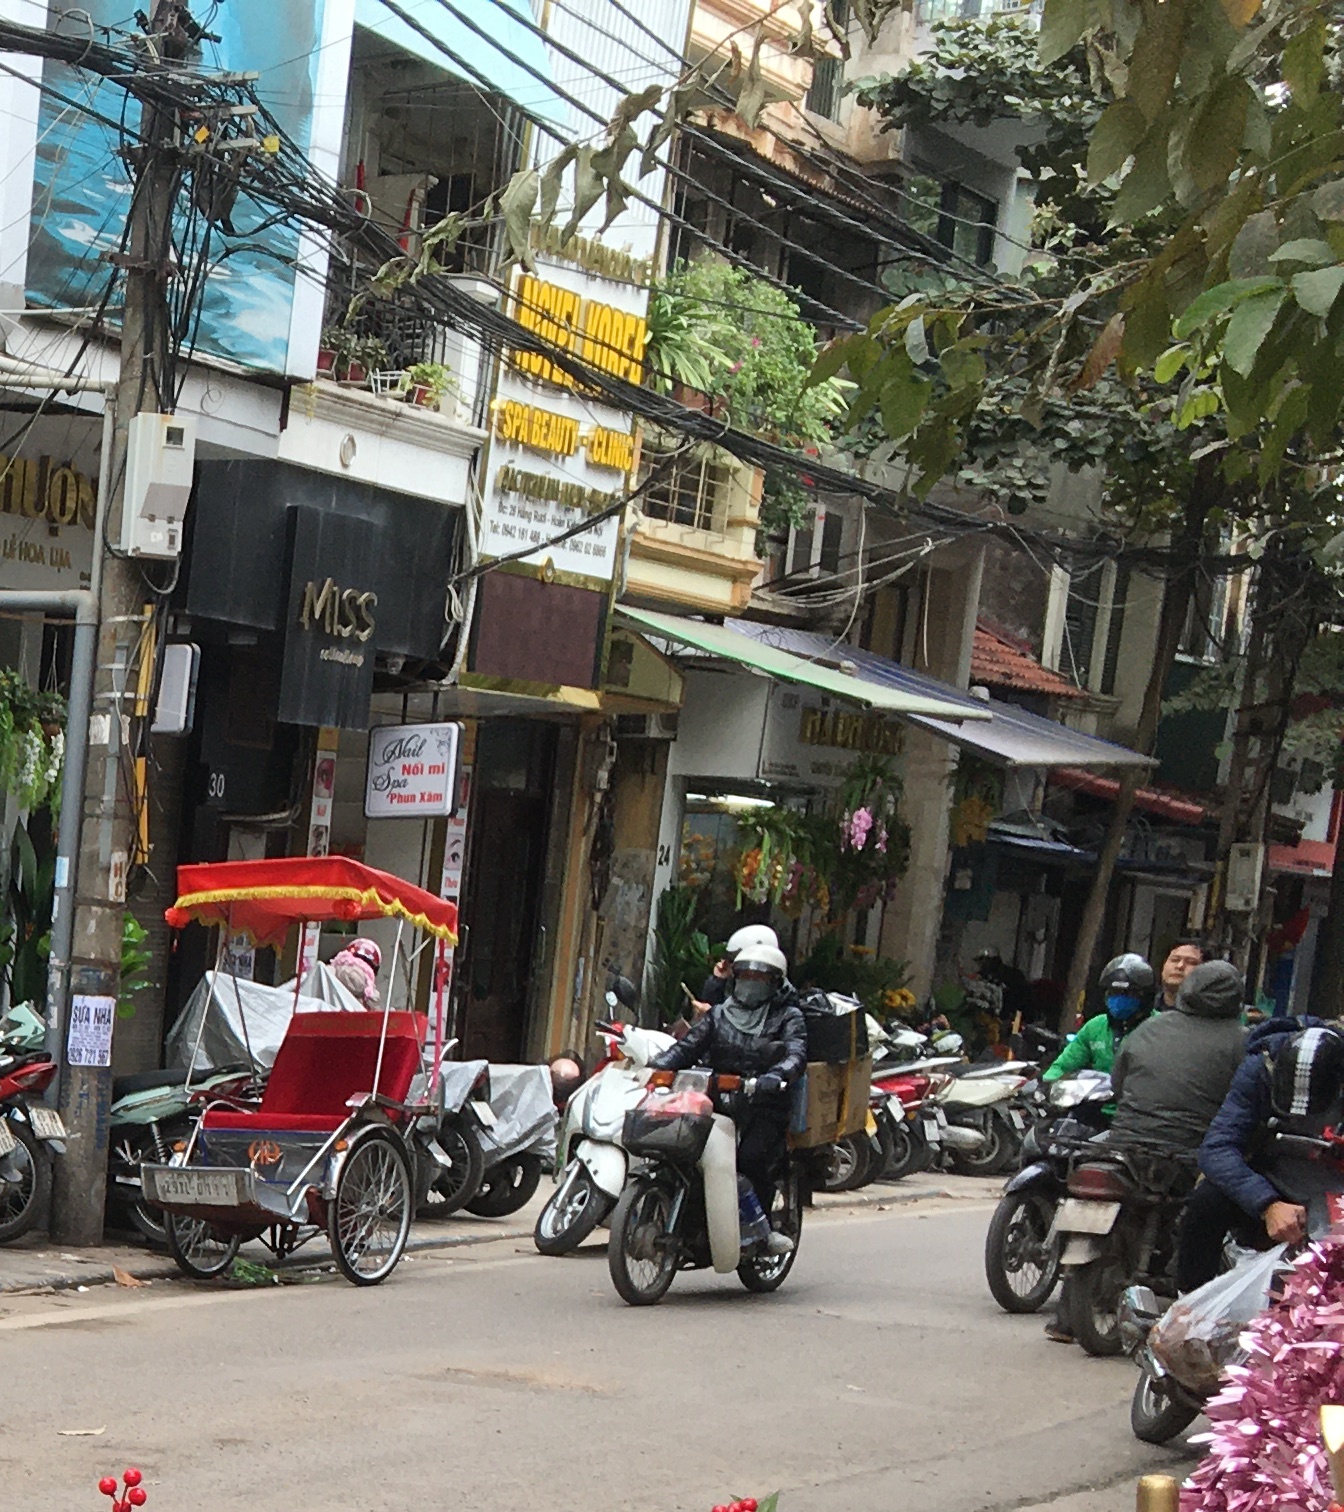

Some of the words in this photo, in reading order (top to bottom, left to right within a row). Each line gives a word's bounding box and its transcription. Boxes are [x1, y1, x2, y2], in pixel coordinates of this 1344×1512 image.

[502, 400, 532, 443] SPA
[531, 407, 581, 457] BEAUTY
[592, 427, 634, 471] CLINIC
[374, 734, 428, 768] Nail
[208, 772, 225, 798] 30
[372, 767, 409, 799] Spa
[389, 792, 416, 805] Phun
[658, 844, 671, 867] 24
